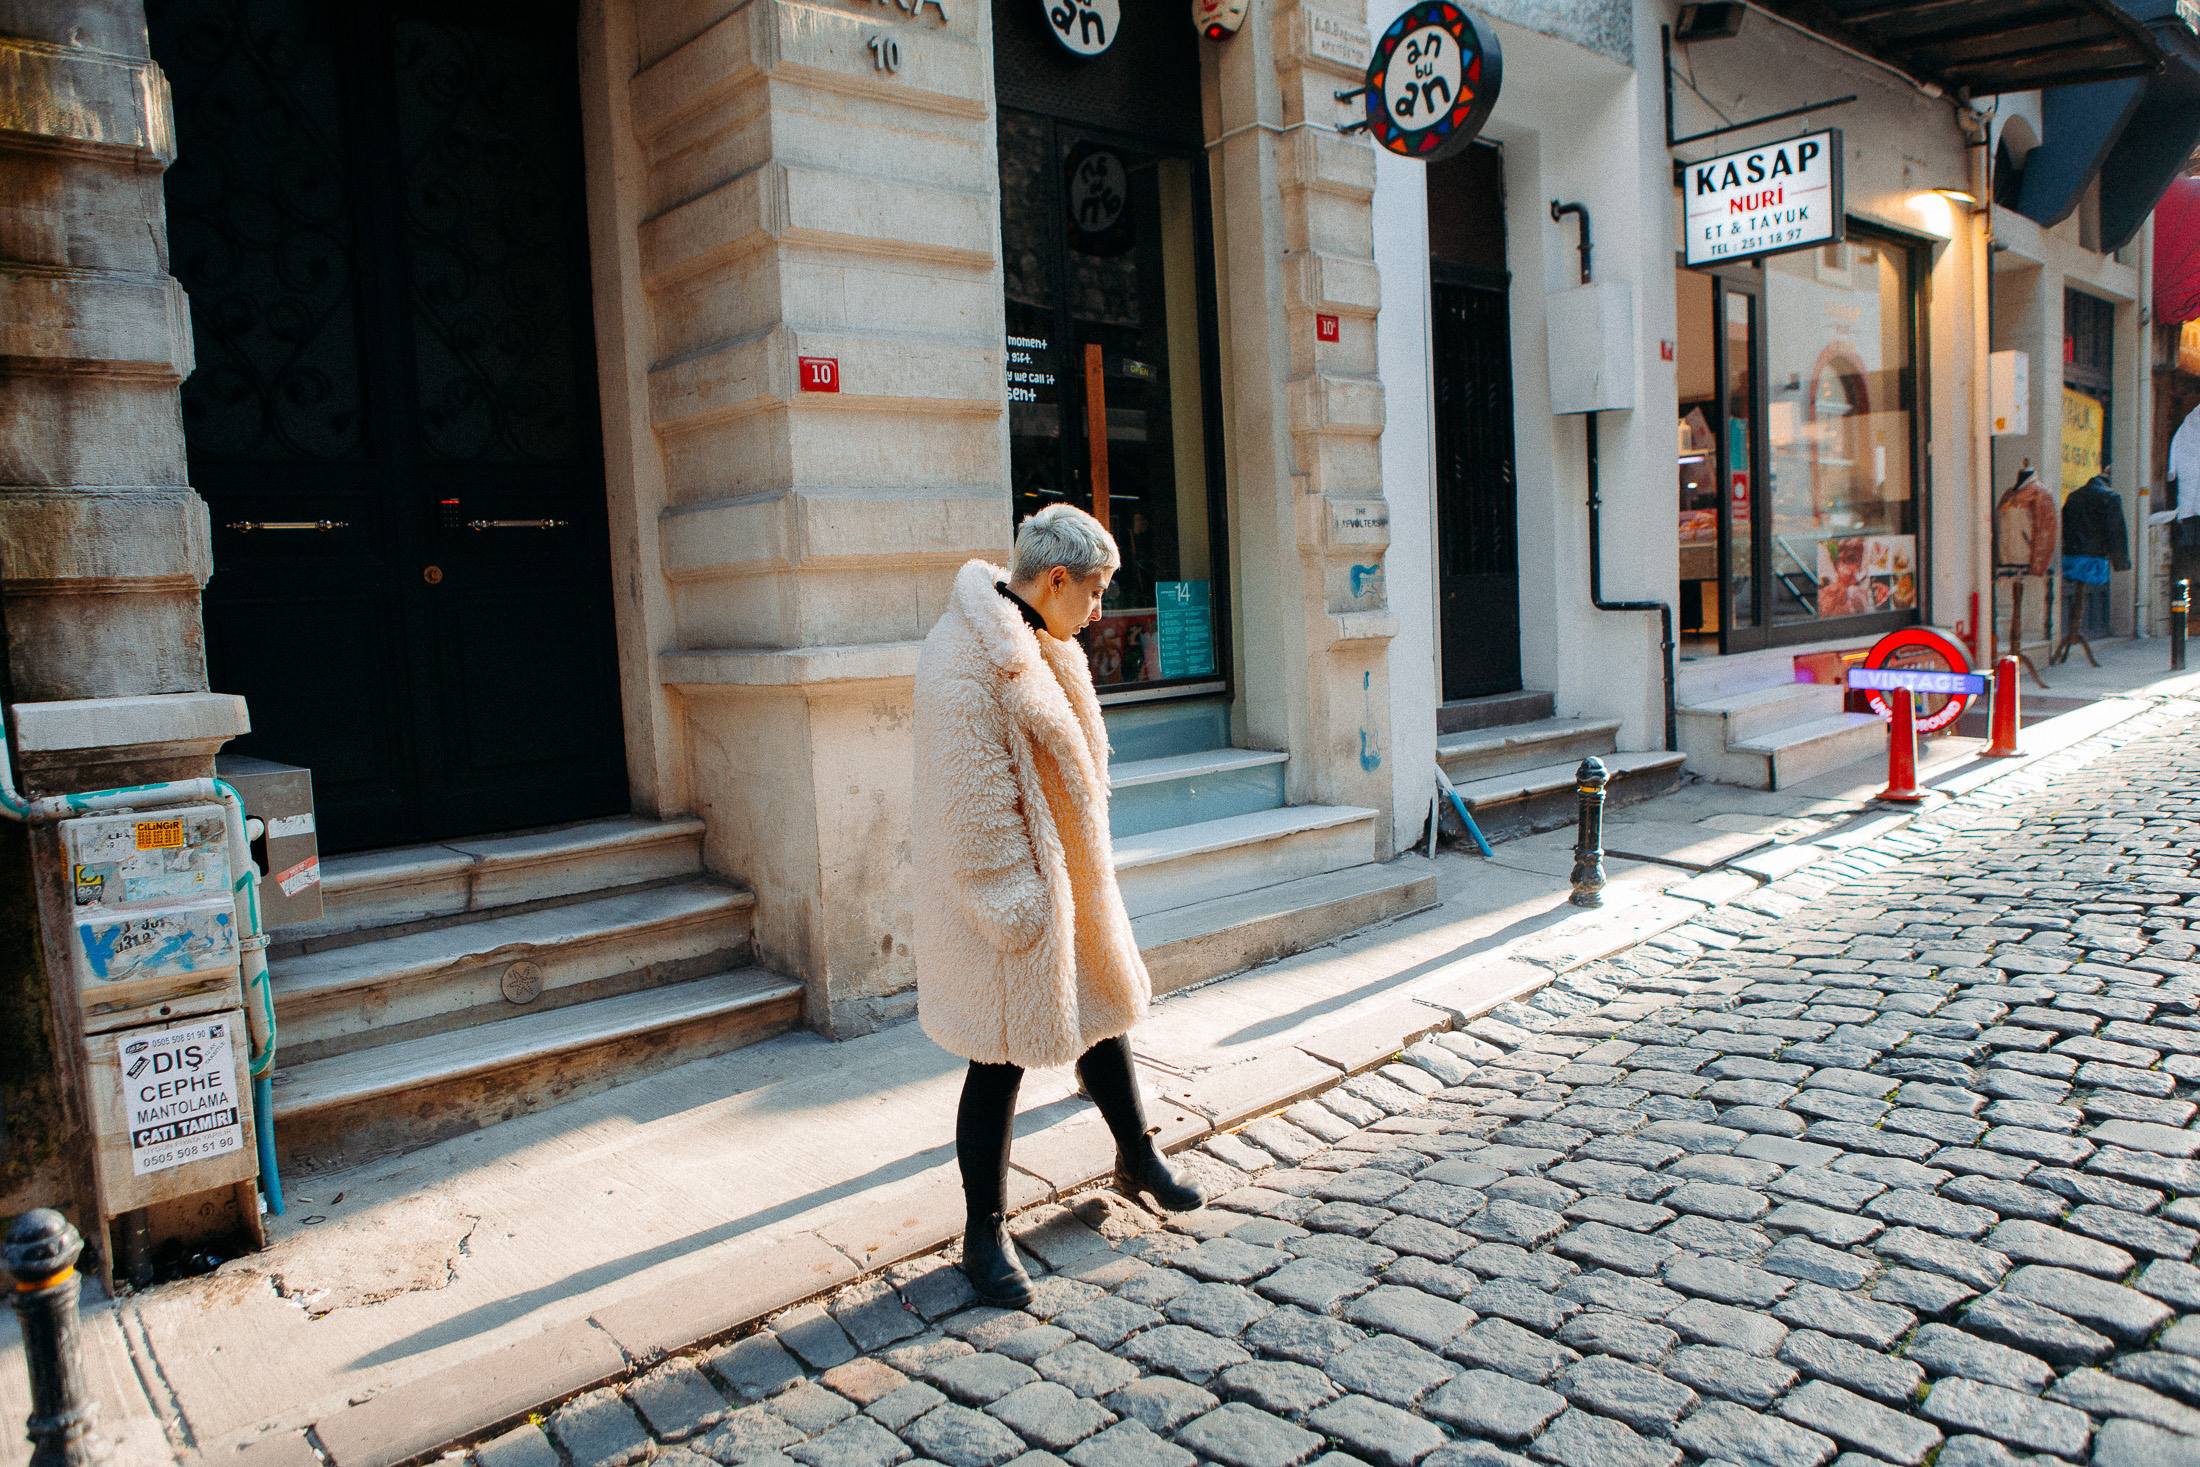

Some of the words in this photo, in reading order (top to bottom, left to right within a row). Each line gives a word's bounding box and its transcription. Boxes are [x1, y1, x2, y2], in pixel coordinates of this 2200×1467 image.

[867, 35, 900, 73] 10
[1407, 32, 1442, 64] an
[1395, 75, 1451, 117] an
[1697, 140, 1820, 196] KASAP
[1730, 182, 1783, 215] NURİ
[1705, 224, 1722, 240] ET
[1731, 221, 1741, 235] &
[1749, 206, 1808, 230] TAVUK
[1711, 243, 1728, 255] TEL
[1742, 236, 1762, 250] 251
[1787, 228, 1802, 240] 97
[1007, 335, 1048, 350] moment
[812, 364, 831, 384] 10
[1014, 372, 1028, 383] we
[1028, 373, 1045, 384] call
[1046, 374, 1056, 385] it
[1129, 364, 1149, 377] OPEN
[1174, 582, 1191, 602] 14
[1867, 672, 1966, 693] VINTAGE
[152, 1045, 204, 1074] DIŞ
[140, 1070, 223, 1103] CEPHE
[137, 1091, 229, 1125] MANTOLAMA
[138, 1124, 176, 1147] ÇATI
[178, 1107, 233, 1137] TAMİRİ
[143, 1151, 174, 1167] 0505
[177, 1145, 199, 1158] 508
[202, 1141, 215, 1152] 51
[219, 1136, 234, 1148] 90
